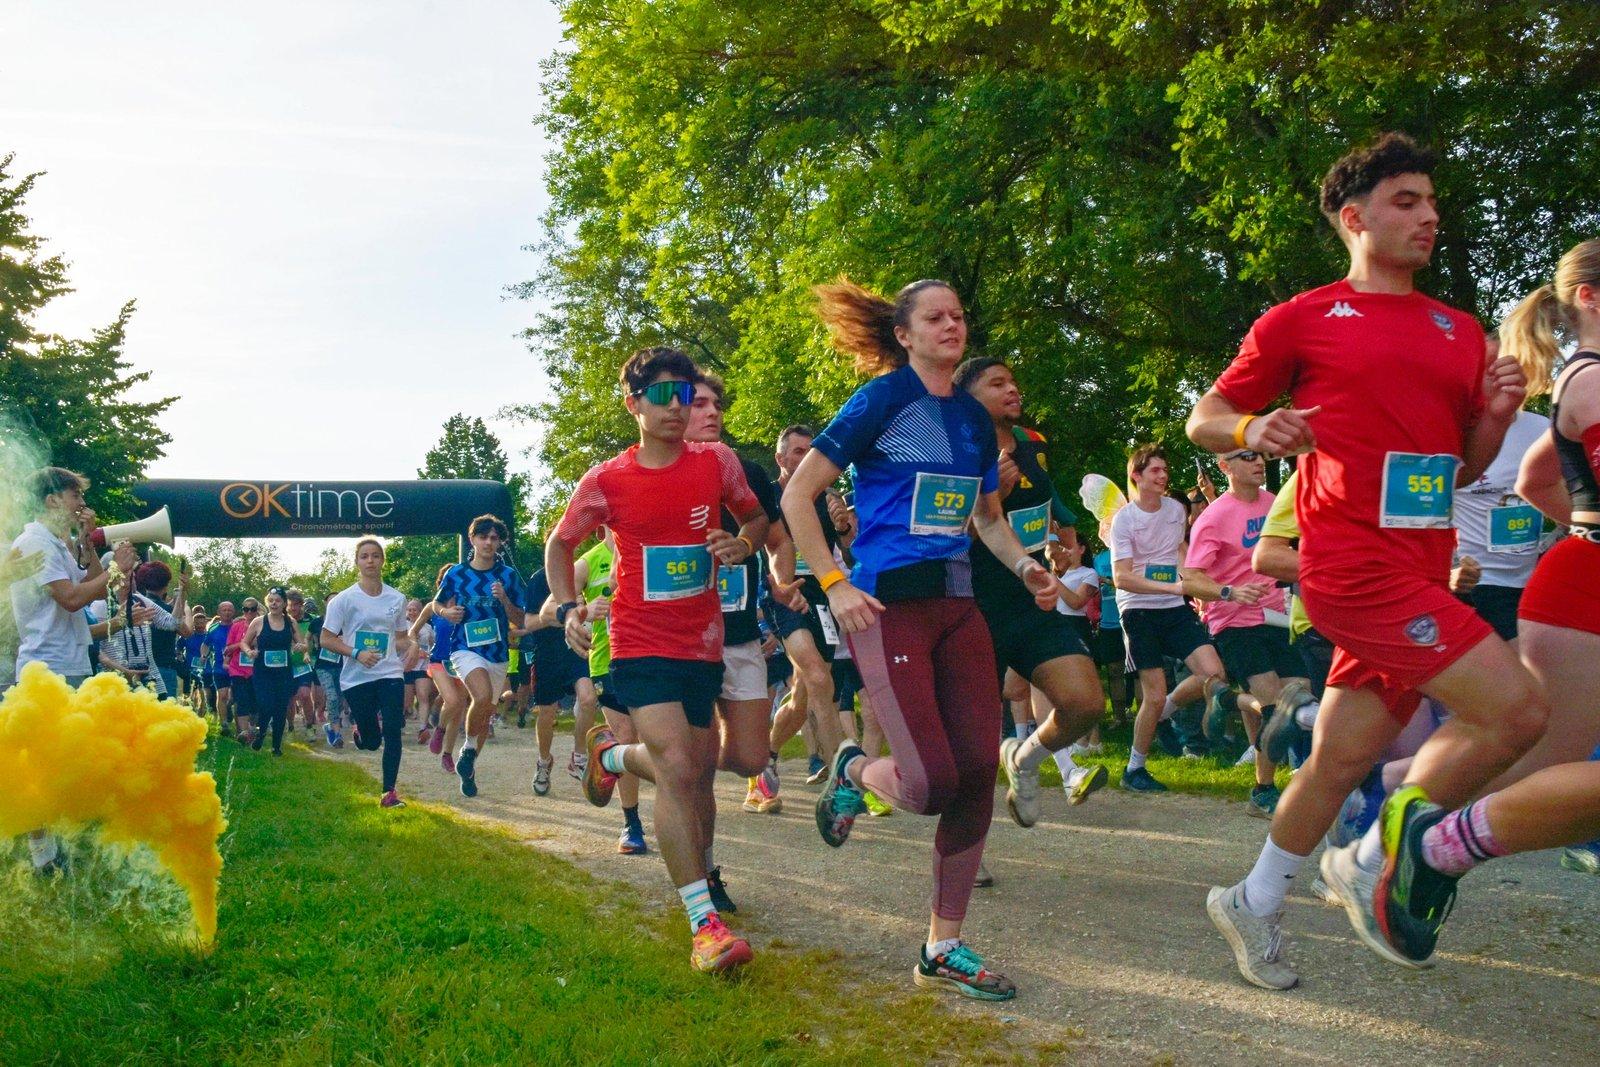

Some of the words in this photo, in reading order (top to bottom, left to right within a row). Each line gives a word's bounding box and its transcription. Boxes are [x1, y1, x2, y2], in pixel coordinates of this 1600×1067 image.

[1408, 474, 1445, 494] 551
[933, 491, 966, 509] 573
[364, 522, 395, 530] sportif
[1507, 517, 1532, 531] 891
[666, 560, 698, 575] 561
